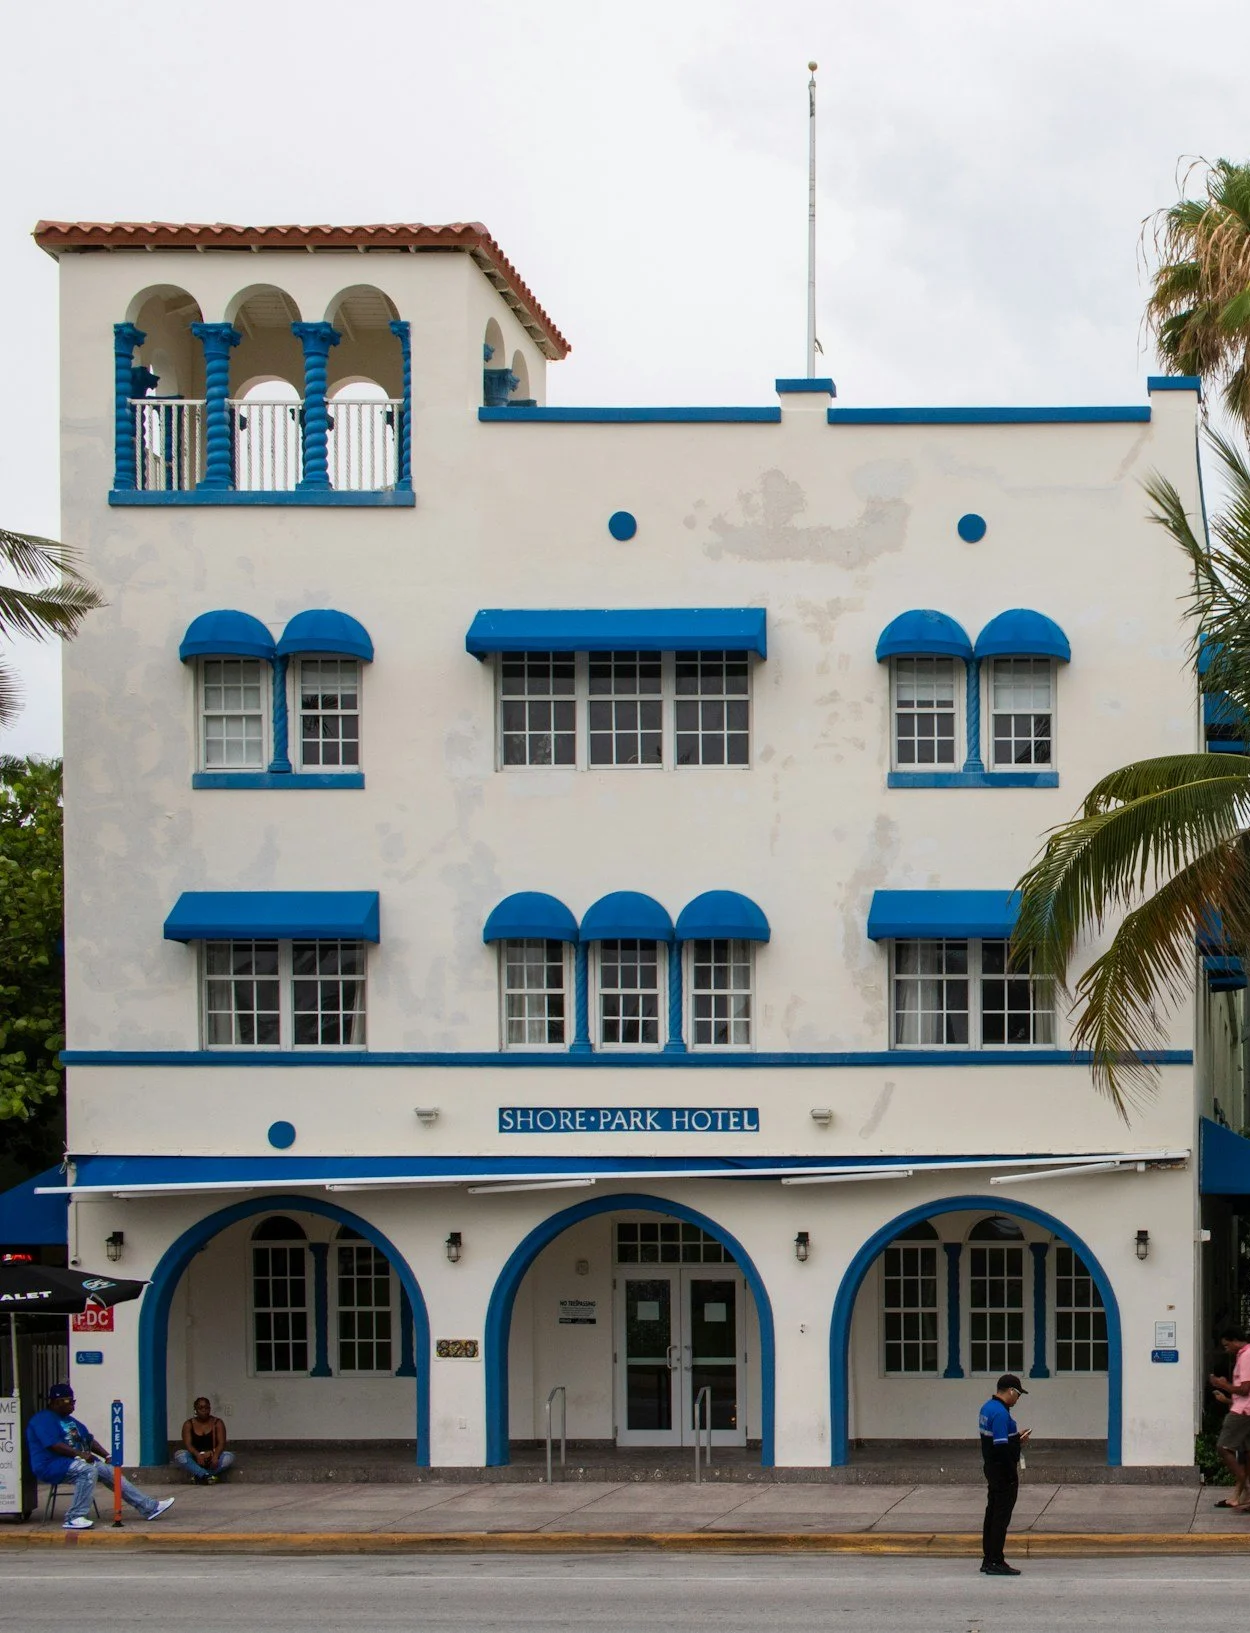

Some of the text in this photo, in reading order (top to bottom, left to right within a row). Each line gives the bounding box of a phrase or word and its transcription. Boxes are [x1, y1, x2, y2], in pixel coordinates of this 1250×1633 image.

[672, 1110, 757, 1131] HOTEL
[77, 1310, 109, 1326] FDC
[113, 1407, 121, 1450] VALET
